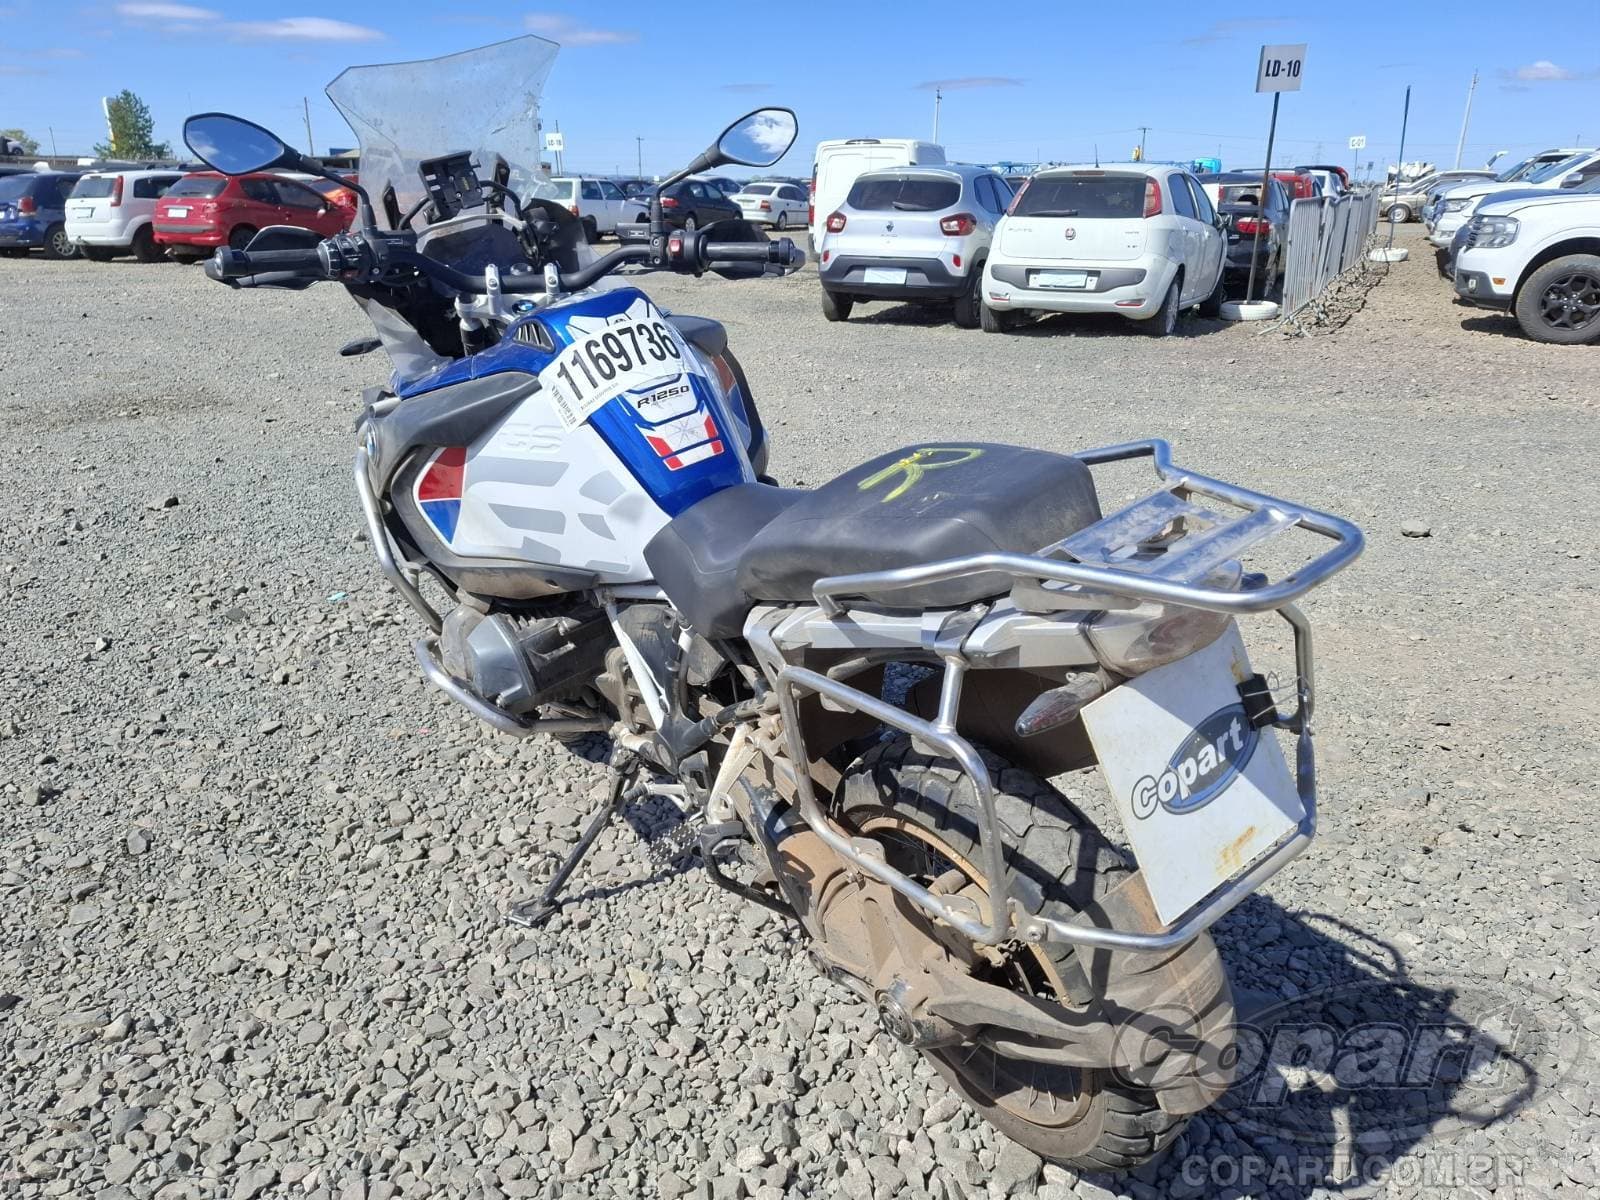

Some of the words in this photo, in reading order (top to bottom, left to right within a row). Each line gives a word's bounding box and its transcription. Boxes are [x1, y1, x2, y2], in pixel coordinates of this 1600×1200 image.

[1265, 60, 1301, 77] LD-10
[557, 322, 681, 401] 1169736
[637, 385, 690, 409] R1250
[1131, 716, 1245, 821] Copart
